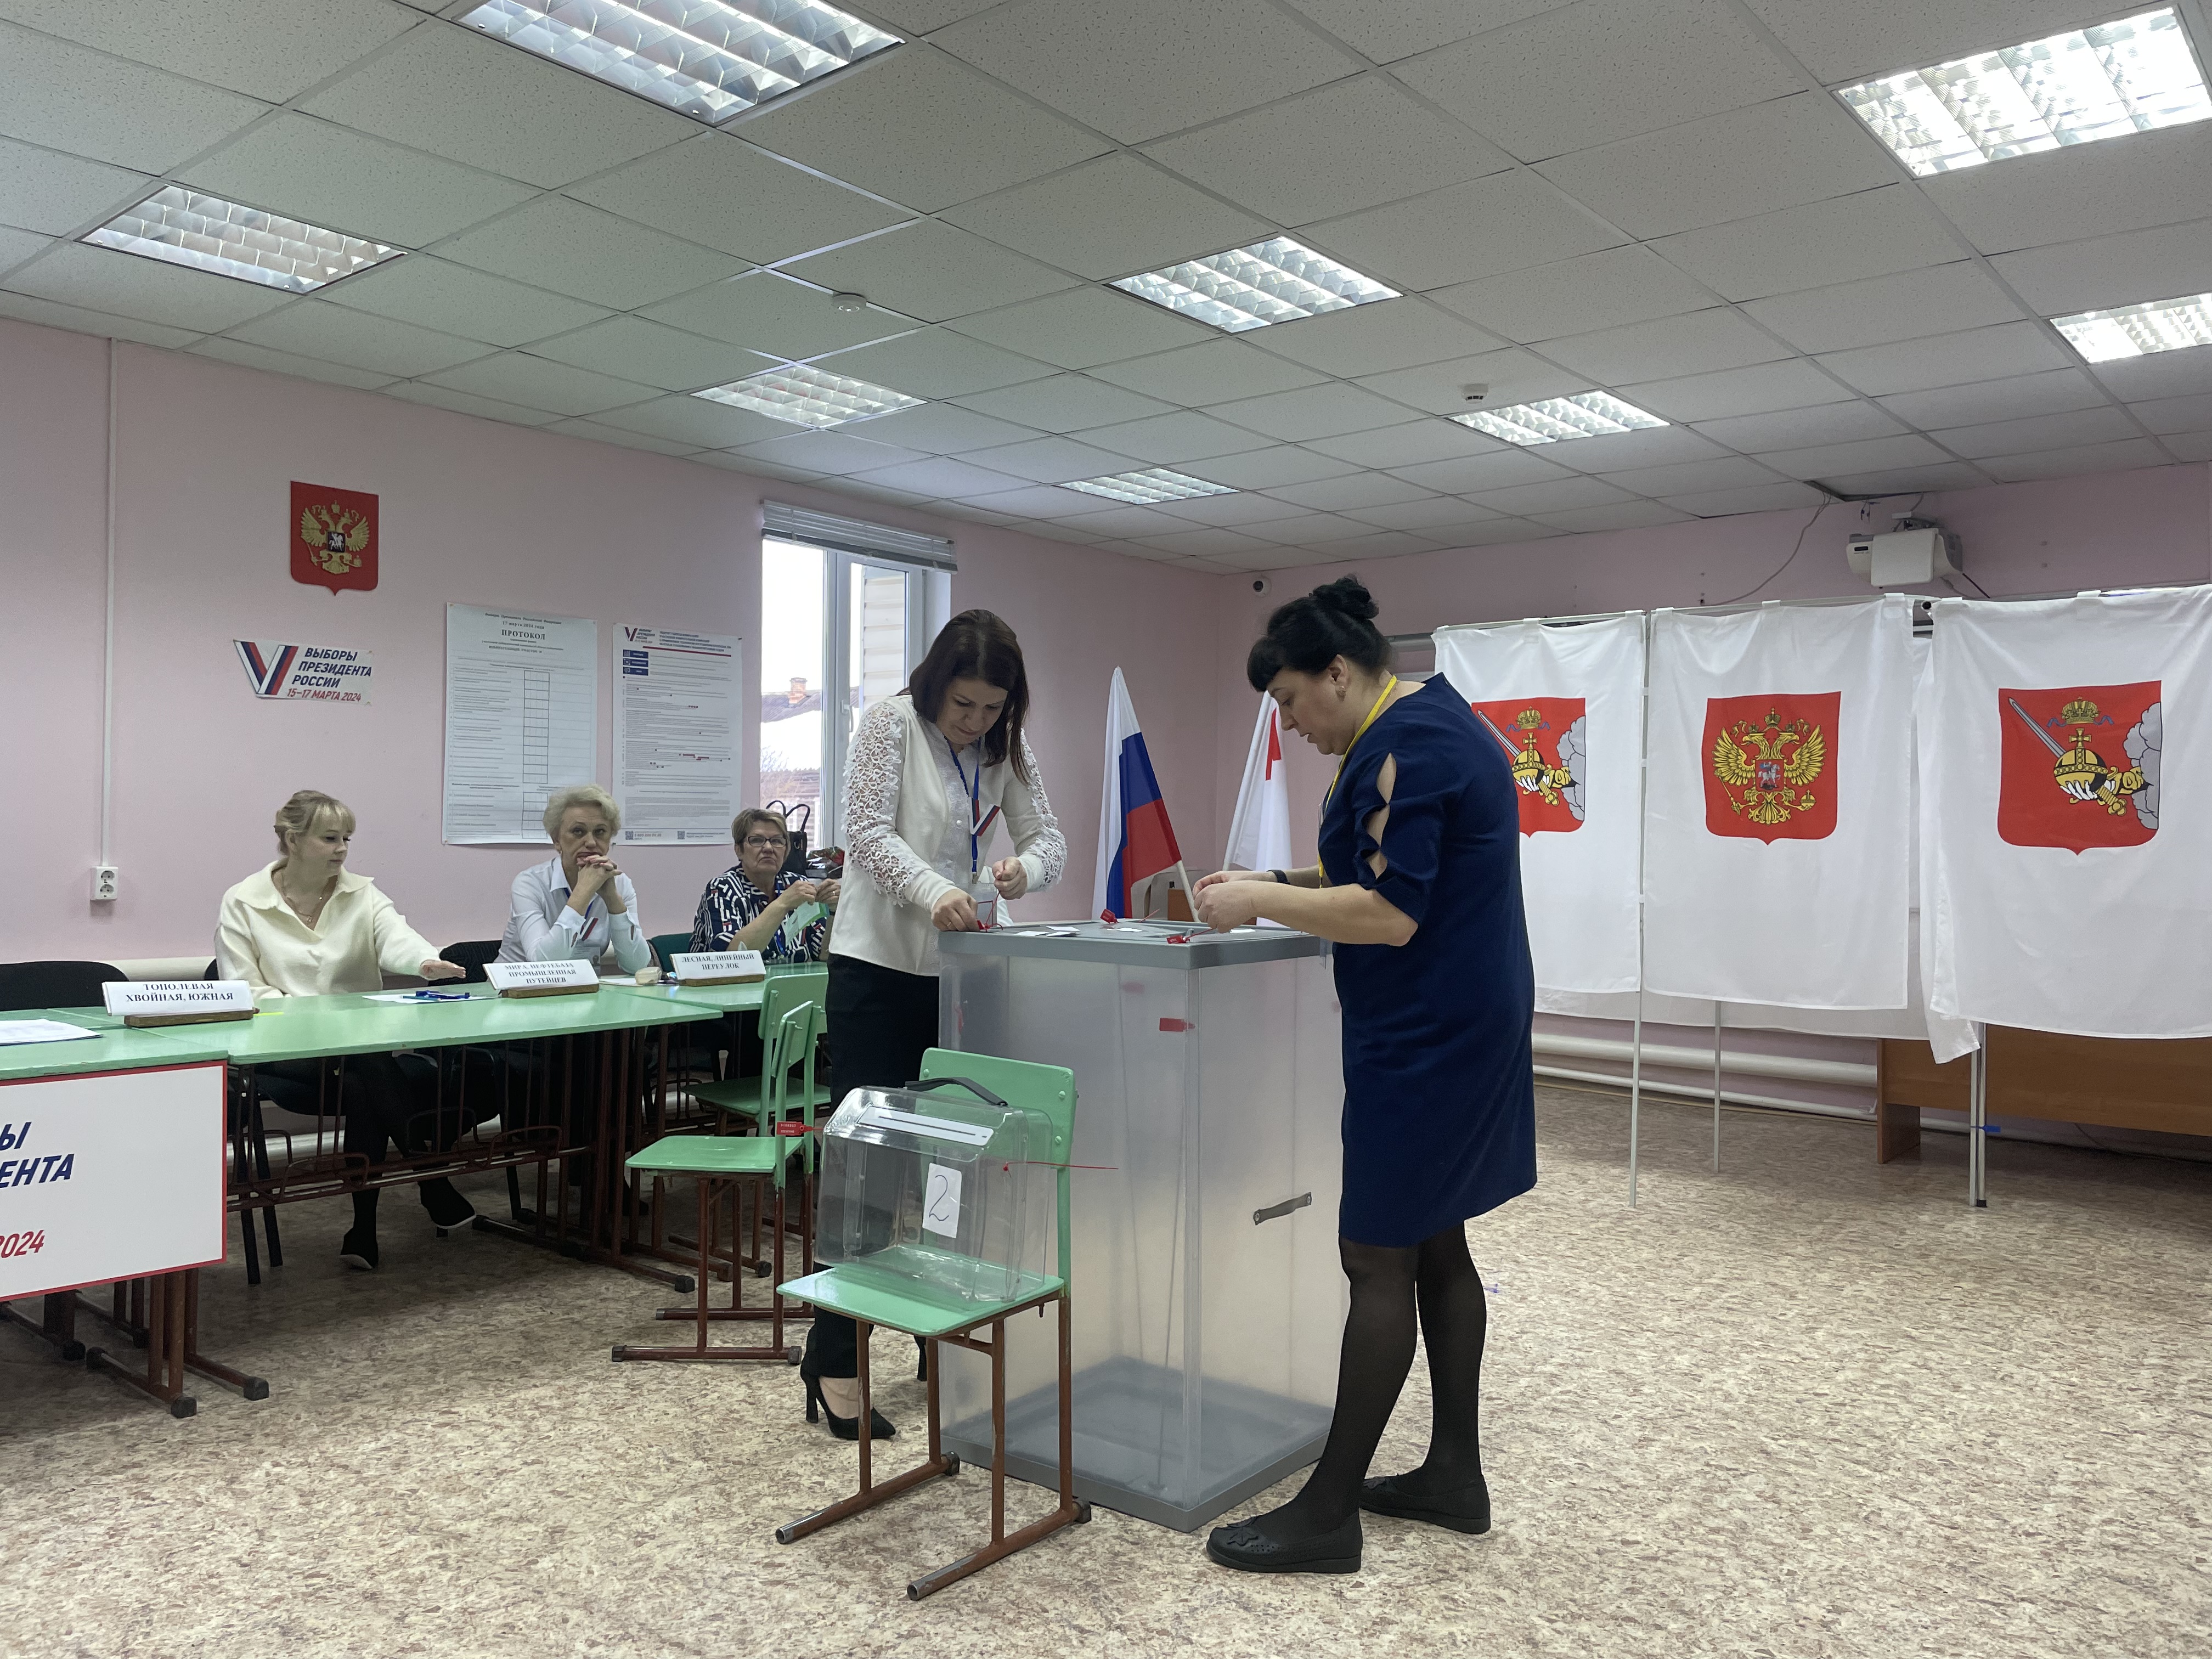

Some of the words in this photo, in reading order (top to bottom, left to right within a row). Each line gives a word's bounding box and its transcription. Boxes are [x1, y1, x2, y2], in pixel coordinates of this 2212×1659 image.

[501, 629, 545, 640] ПРОТОКОЛ
[304, 647, 358, 662] ВЫБОРЫ
[298, 661, 372, 676] ПРЕЗИДЕНТА
[291, 675, 341, 688] РОССИИ
[311, 690, 341, 701] МАРТА
[341, 692, 362, 702] 2024
[714, 953, 754, 961] ЛИНЕЙНЫЙ
[126, 992, 186, 1002] ХВОЙНАЯ,
[188, 992, 234, 1001] ЮЖНАЯ
[928, 1175, 950, 1221] 2
